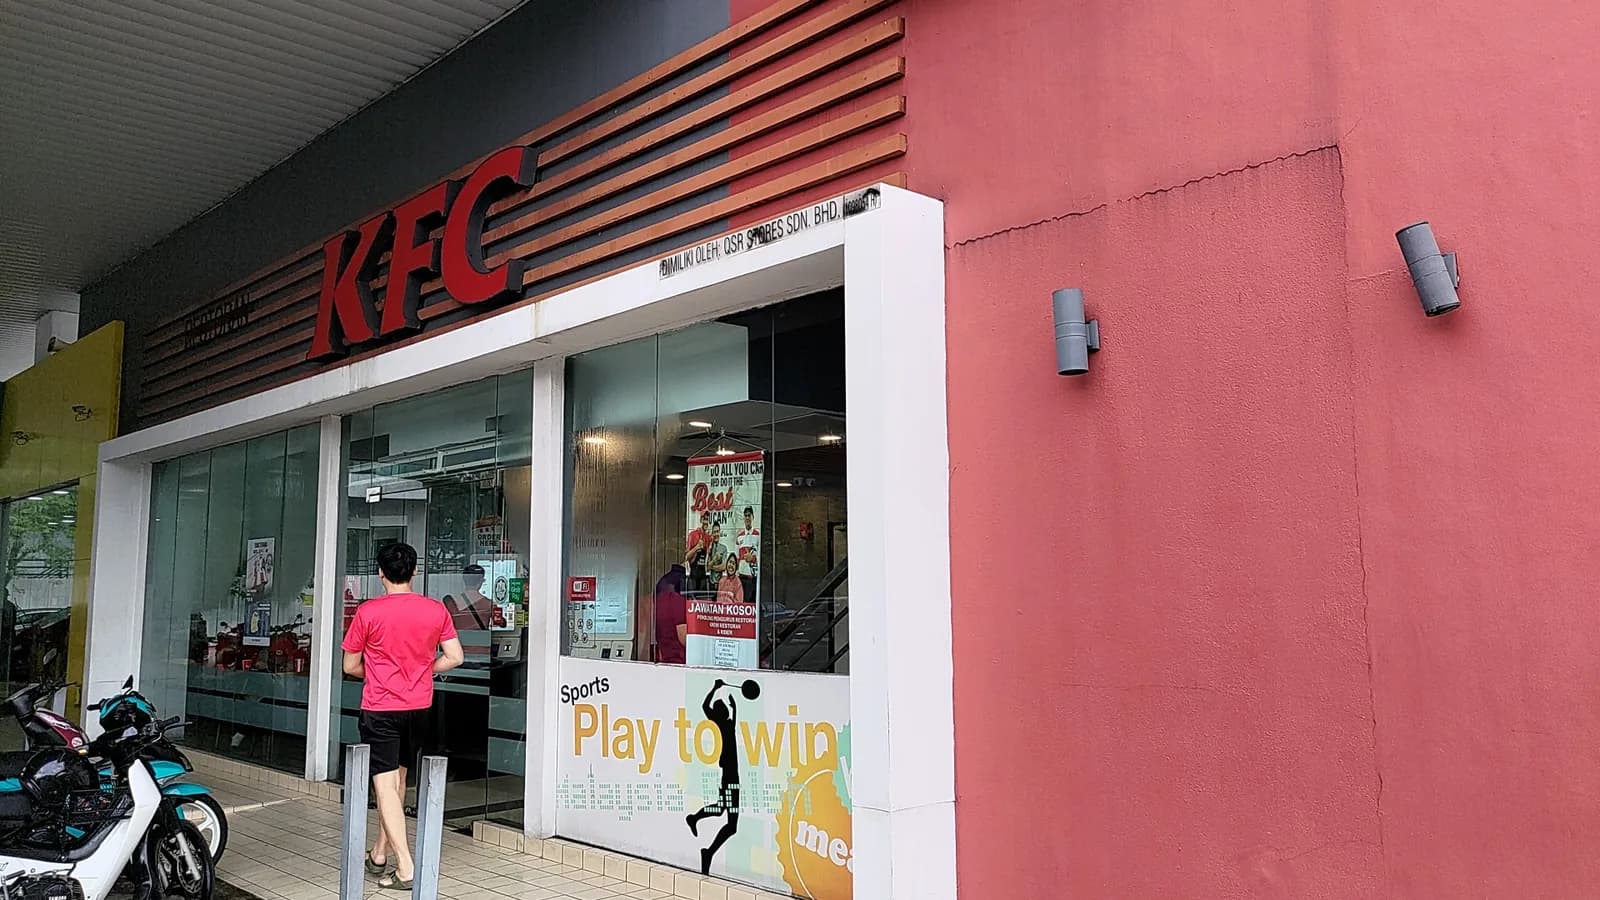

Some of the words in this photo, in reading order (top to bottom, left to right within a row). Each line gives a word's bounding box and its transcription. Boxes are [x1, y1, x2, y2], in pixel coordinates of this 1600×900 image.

[306, 145, 539, 361] KFC
[659, 251, 694, 277] DIMILIKI
[696, 240, 721, 264] OLEH:
[723, 231, 745, 255] QSR
[746, 217, 784, 250] STORES
[786, 208, 811, 238] SDN.
[814, 201, 841, 226] BHD.
[721, 464, 733, 476] ALL
[734, 462, 749, 476] YOU
[691, 482, 733, 512] Best
[687, 602, 724, 615] JAWATAN
[560, 676, 610, 705] Sports
[573, 703, 661, 775] Play
[674, 707, 723, 765] to
[740, 704, 838, 769] win
[794, 820, 853, 868] me
